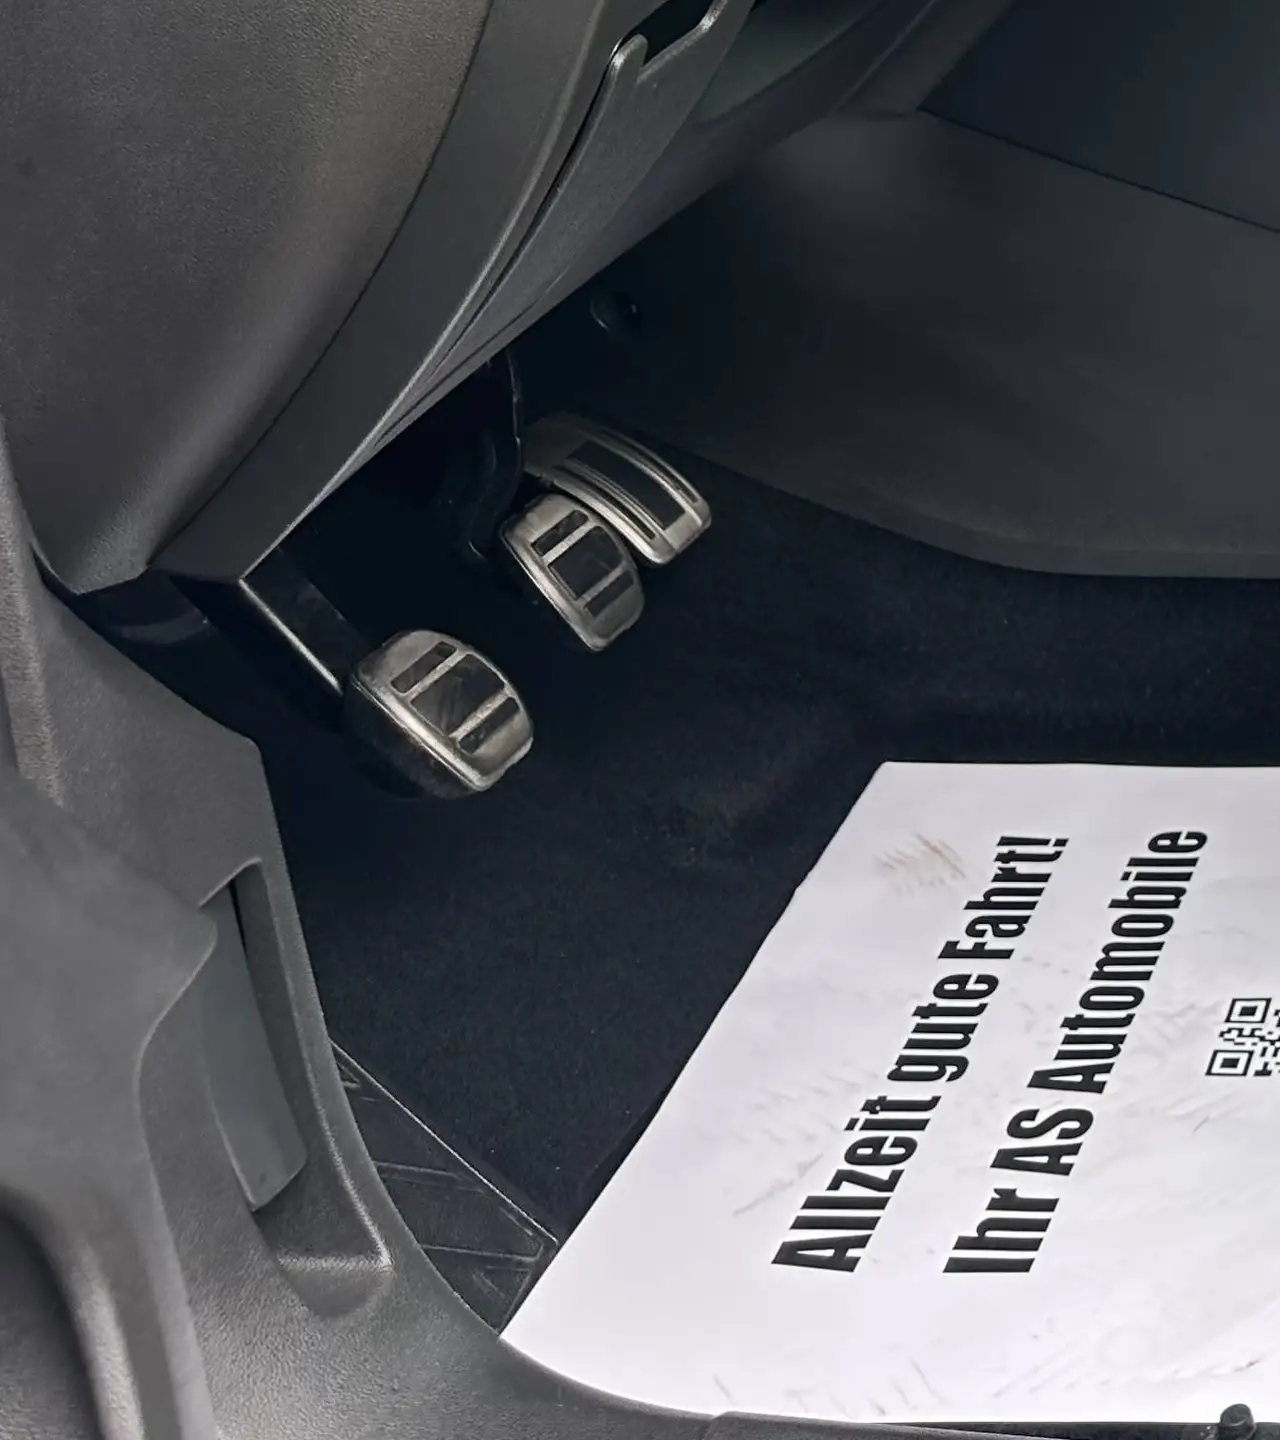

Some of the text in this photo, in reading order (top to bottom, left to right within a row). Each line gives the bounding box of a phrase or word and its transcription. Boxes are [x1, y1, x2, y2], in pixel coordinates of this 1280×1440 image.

[770, 834, 1070, 1274] Allzeit gute Fahrt!
[942, 830, 1209, 1274] Ihr AS Automobile
